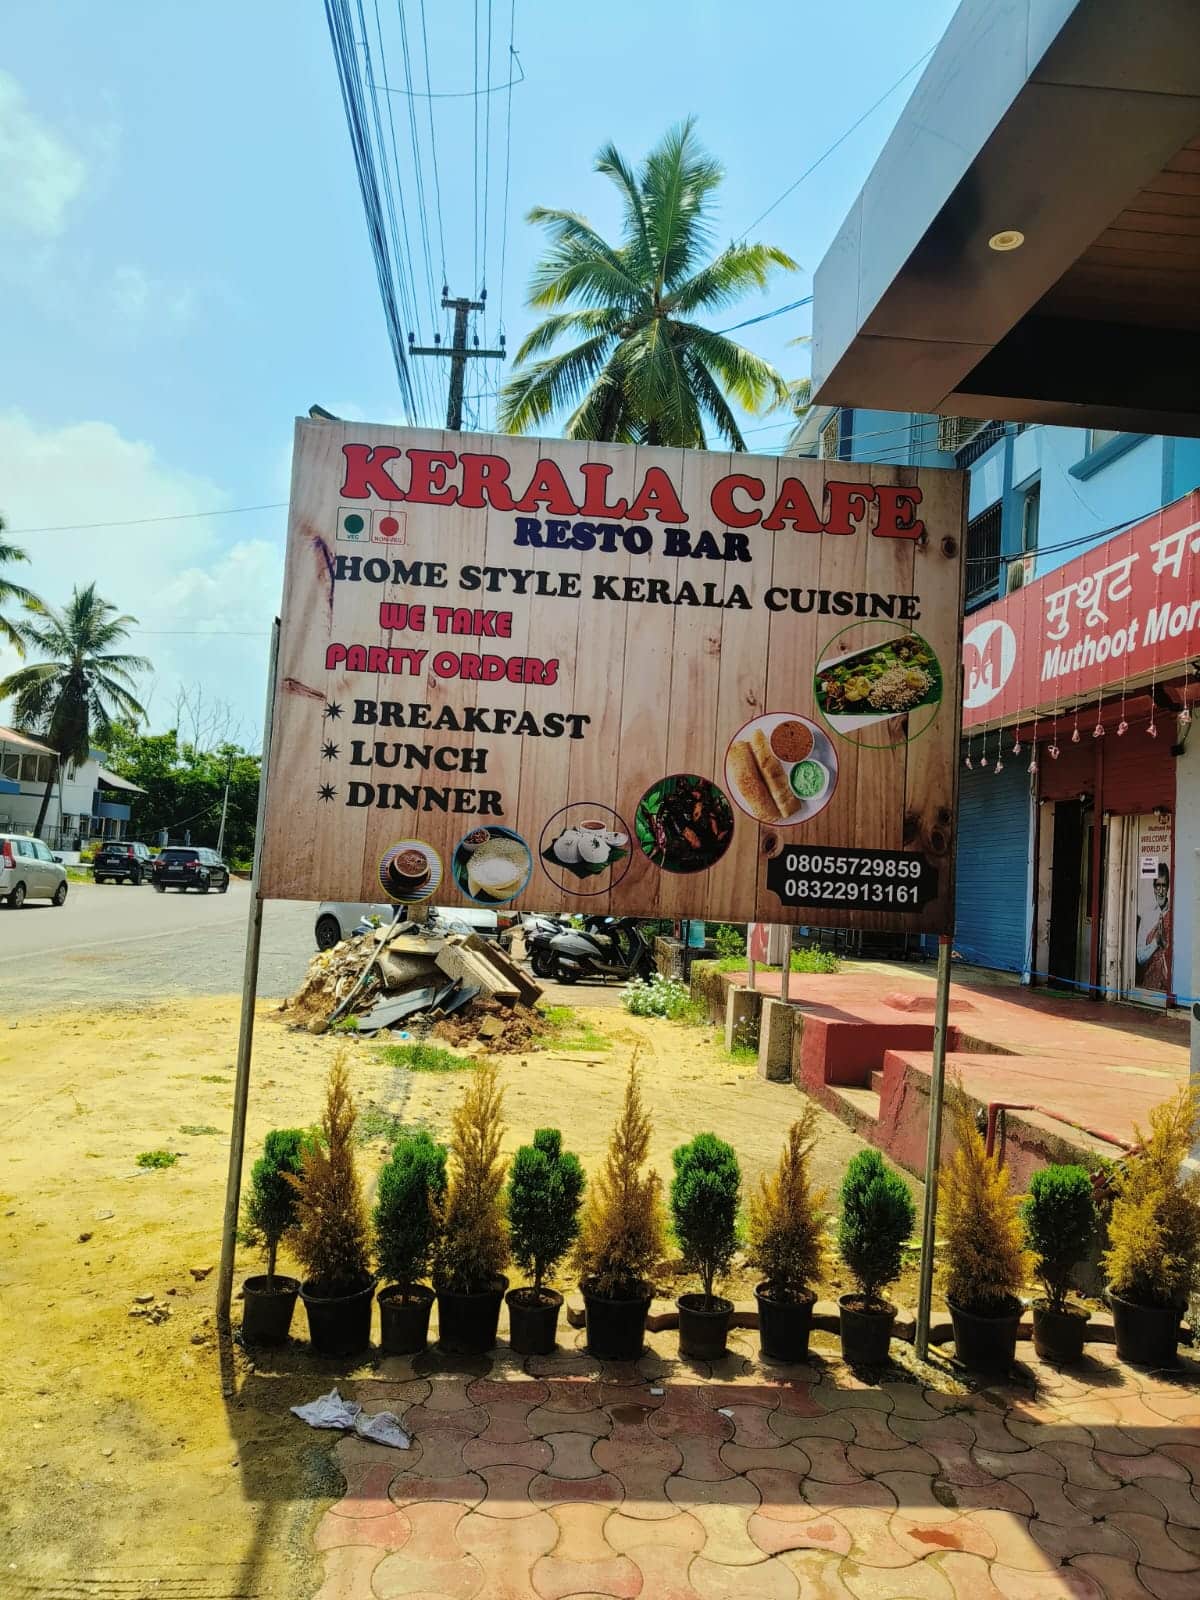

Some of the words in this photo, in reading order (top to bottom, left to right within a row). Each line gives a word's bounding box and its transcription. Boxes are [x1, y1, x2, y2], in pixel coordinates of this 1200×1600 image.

[340, 443, 689, 523] KERALA
[710, 473, 925, 540] CAFE
[513, 517, 653, 554] RESTO
[663, 528, 752, 562] BAR
[334, 555, 448, 588] HOME
[459, 565, 582, 599] STYLE
[592, 574, 753, 610] KERALA
[763, 587, 921, 620] CUISINE
[1045, 552, 1140, 641] मुथूट
[379, 602, 426, 632] WE
[433, 606, 513, 639] TAKE
[325, 643, 429, 676] PARTY
[432, 650, 560, 687] ORDERS
[1040, 617, 1140, 682] Muthoot
[352, 699, 591, 740] BREAKFAST
[349, 740, 489, 774] LUNCH
[345, 781, 504, 816] DINNER
[786, 854, 922, 879] 08055729859
[784, 879, 919, 904] 08322913161
